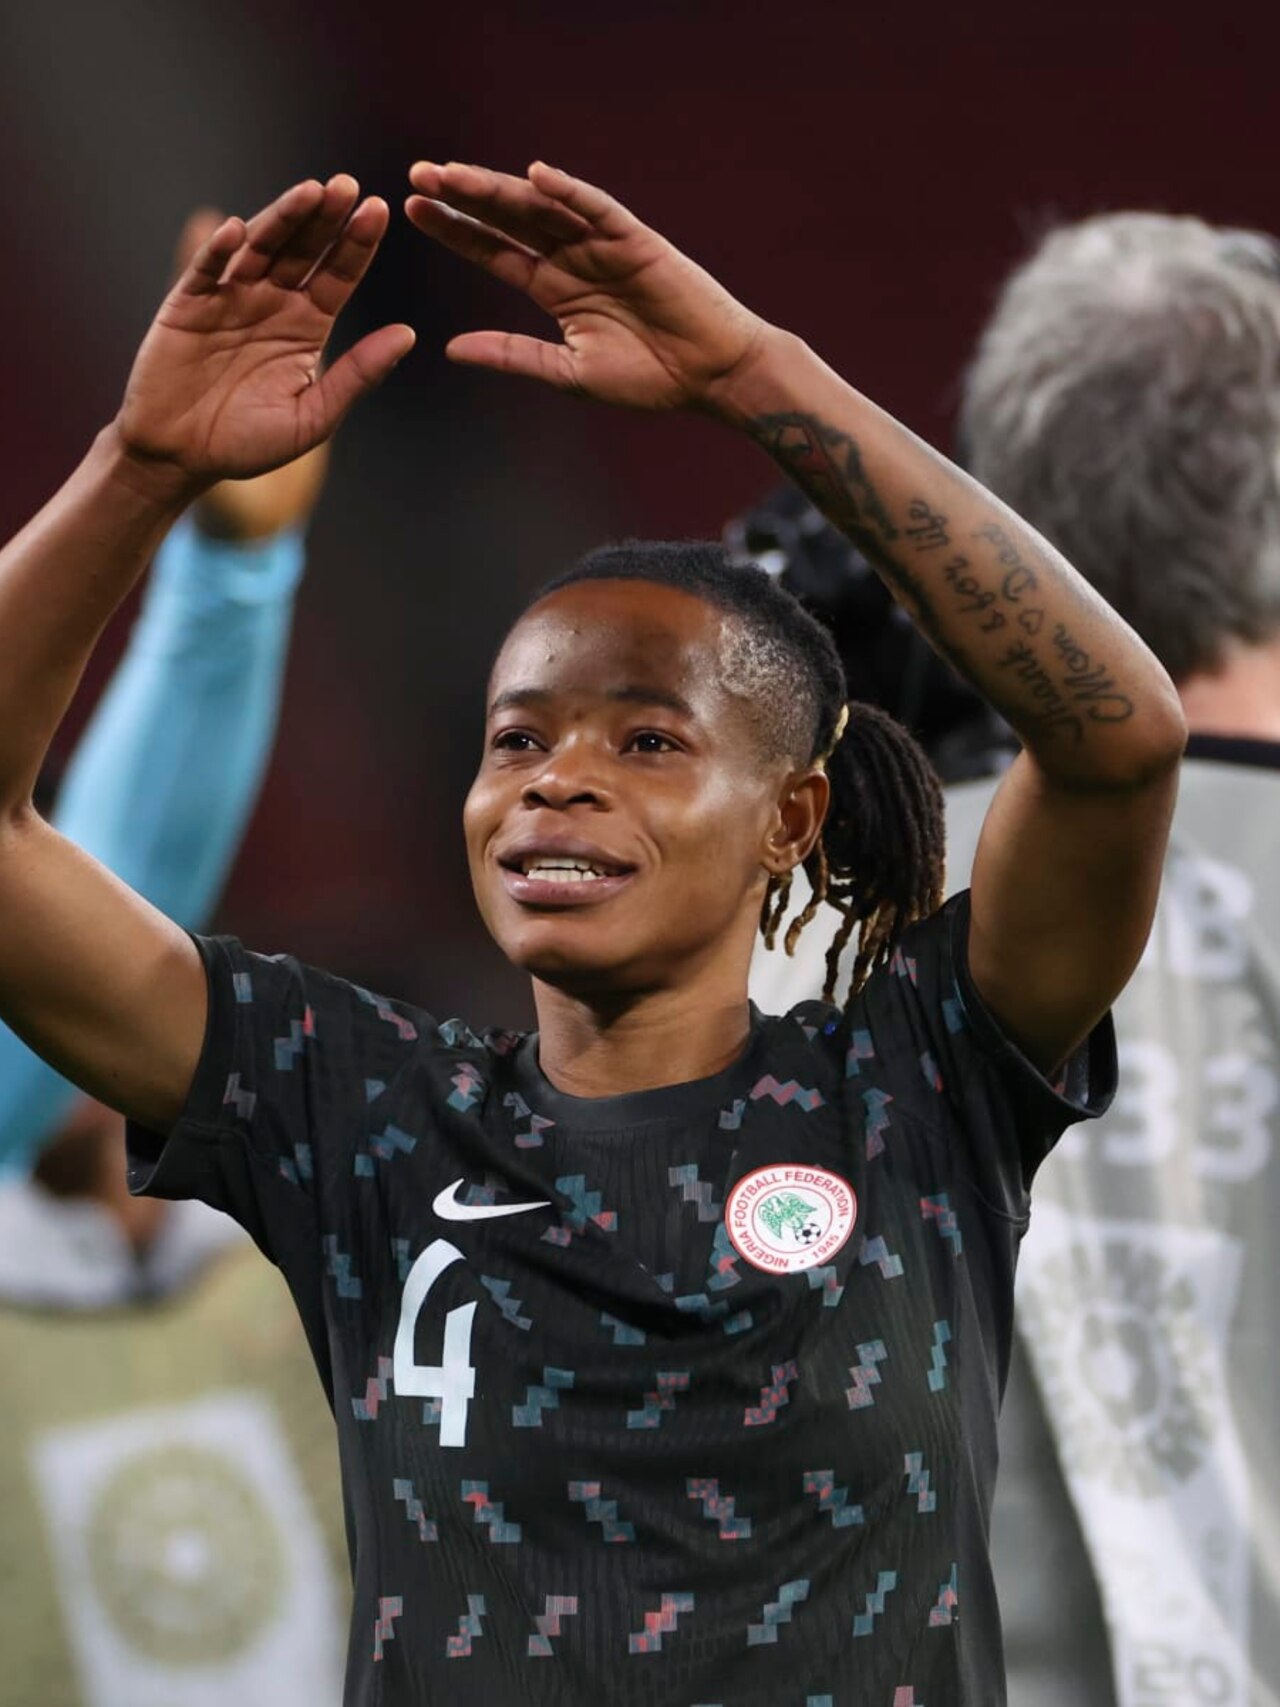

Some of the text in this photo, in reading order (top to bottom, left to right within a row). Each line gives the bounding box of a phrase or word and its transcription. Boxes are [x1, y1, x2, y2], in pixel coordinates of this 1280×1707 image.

[906, 500, 949, 551] life
[972, 523, 1134, 721] Mom Dad
[998, 641, 1083, 742] Thank
[734, 1171, 849, 1268] NIGERIA FOOTBALL FEDERATION
[812, 1234, 839, 1258] 1945
[394, 1238, 477, 1447] 4
